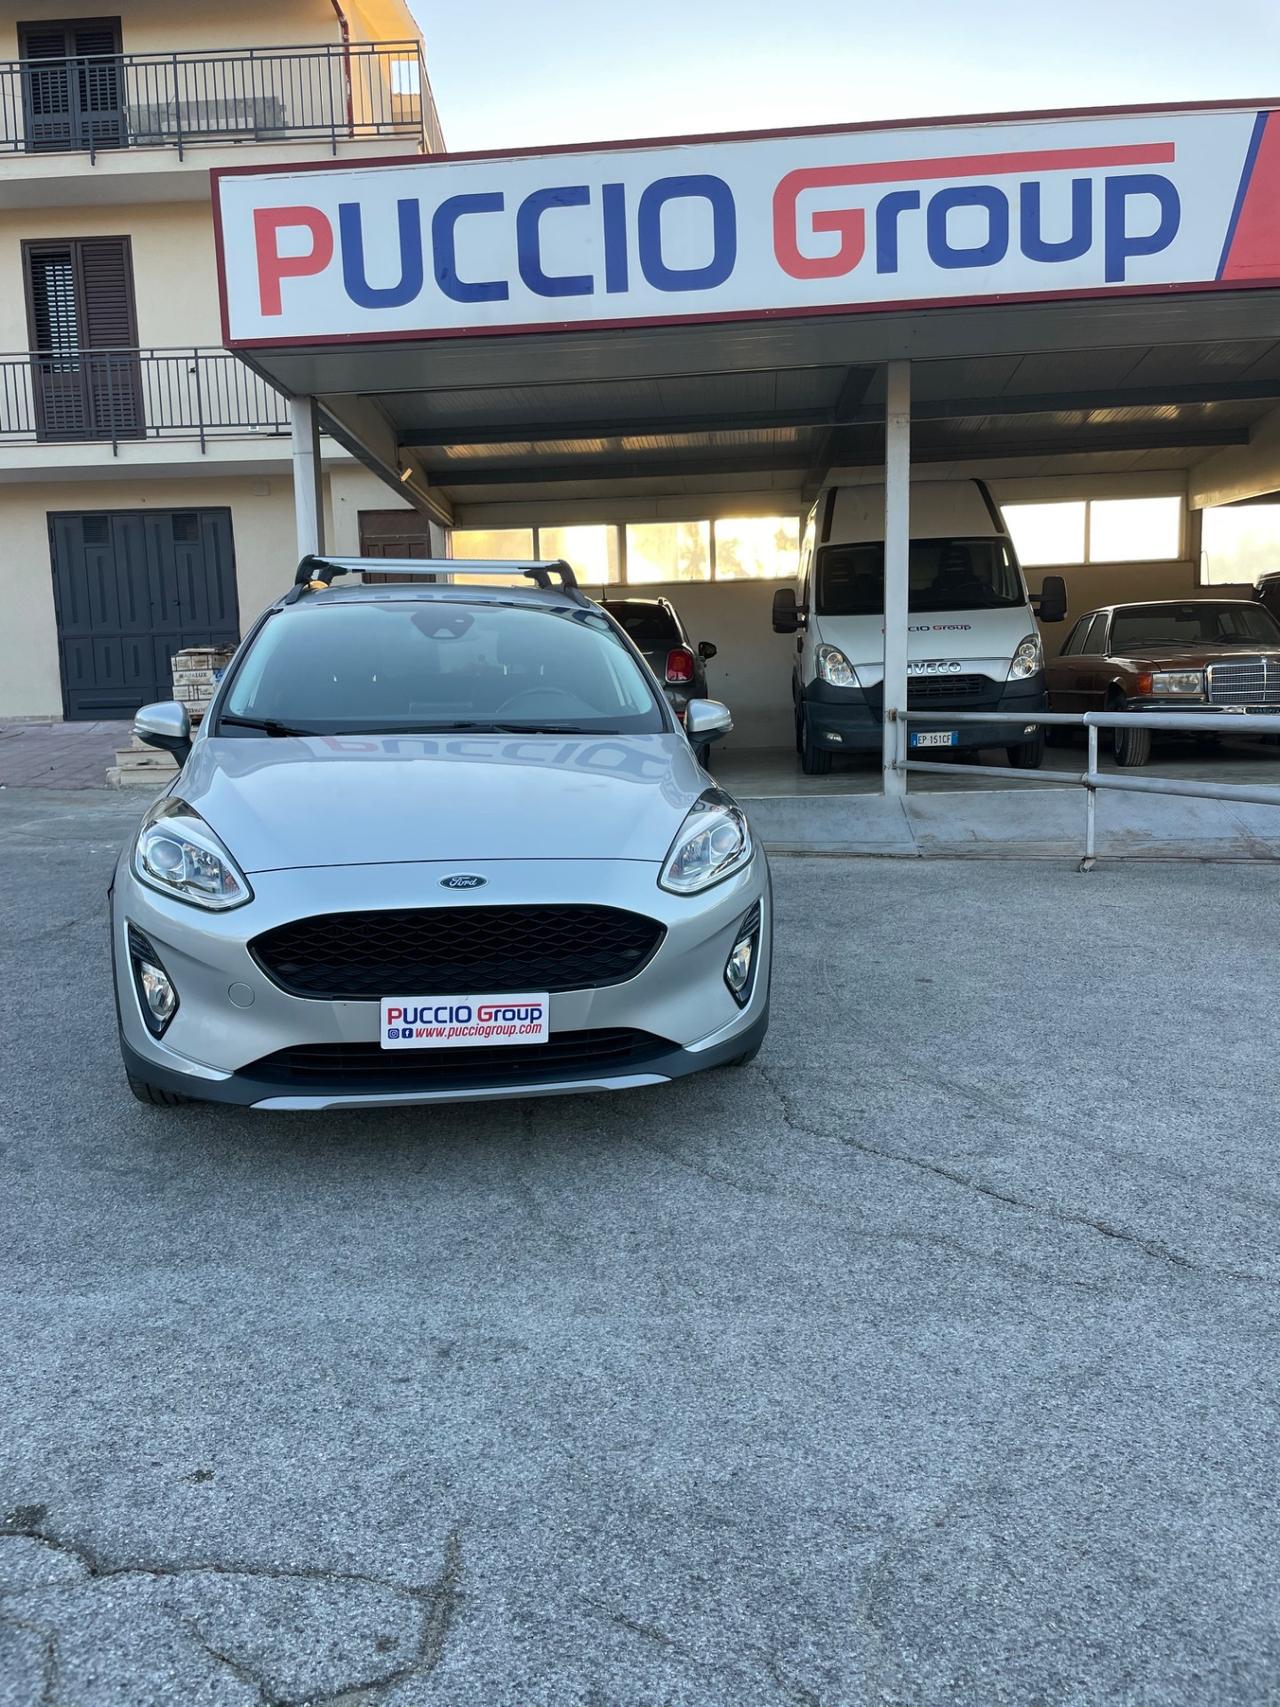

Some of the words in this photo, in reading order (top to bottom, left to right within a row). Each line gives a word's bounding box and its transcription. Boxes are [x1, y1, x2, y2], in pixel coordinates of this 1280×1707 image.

[253, 174, 737, 317] PUCCIO
[773, 142, 1181, 284] Group
[907, 662, 961, 675] IVECO
[918, 735, 927, 744] EP
[449, 876, 478, 887] Ford
[387, 1006, 472, 1025] PUCCIO
[477, 1003, 543, 1024] Group
[415, 1024, 542, 1038] www.pucciogroup.com
